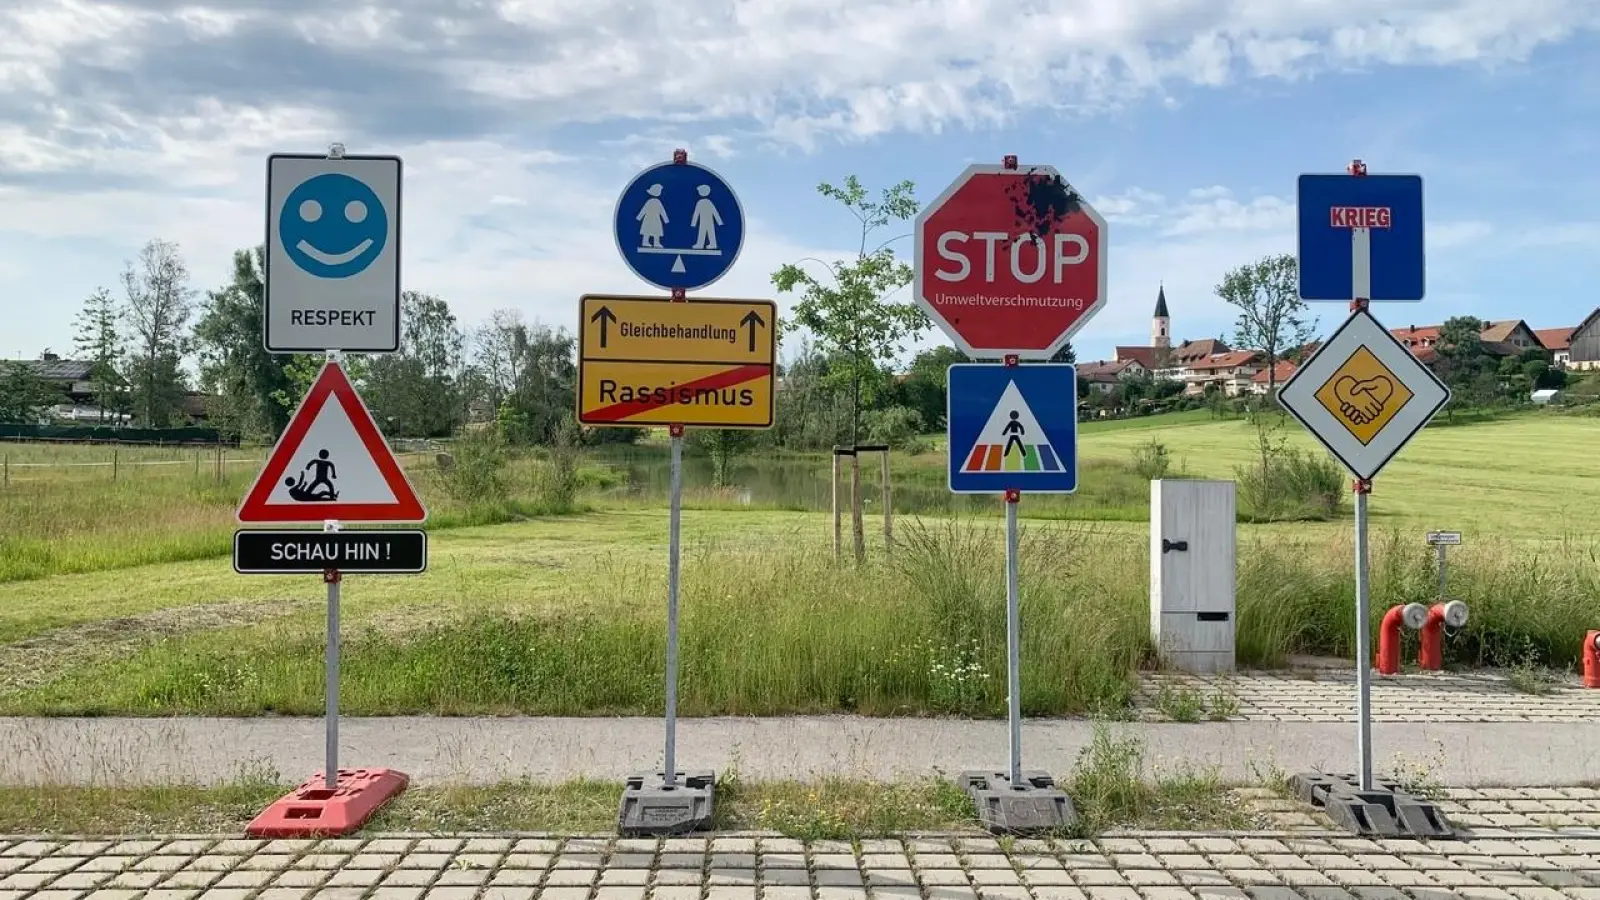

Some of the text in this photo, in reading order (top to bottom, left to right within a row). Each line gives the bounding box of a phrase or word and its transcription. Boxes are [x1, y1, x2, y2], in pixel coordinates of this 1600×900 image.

[1331, 207, 1390, 226] KRIEG
[934, 230, 1090, 284] STOP
[935, 293, 1084, 311] Umweltverschmutzung
[291, 309, 377, 326] RESPEKT
[620, 322, 737, 344] Gleichbehandlung
[599, 379, 754, 407] Rassismus
[270, 543, 339, 561] SCHAU
[344, 543, 380, 561] HIN
